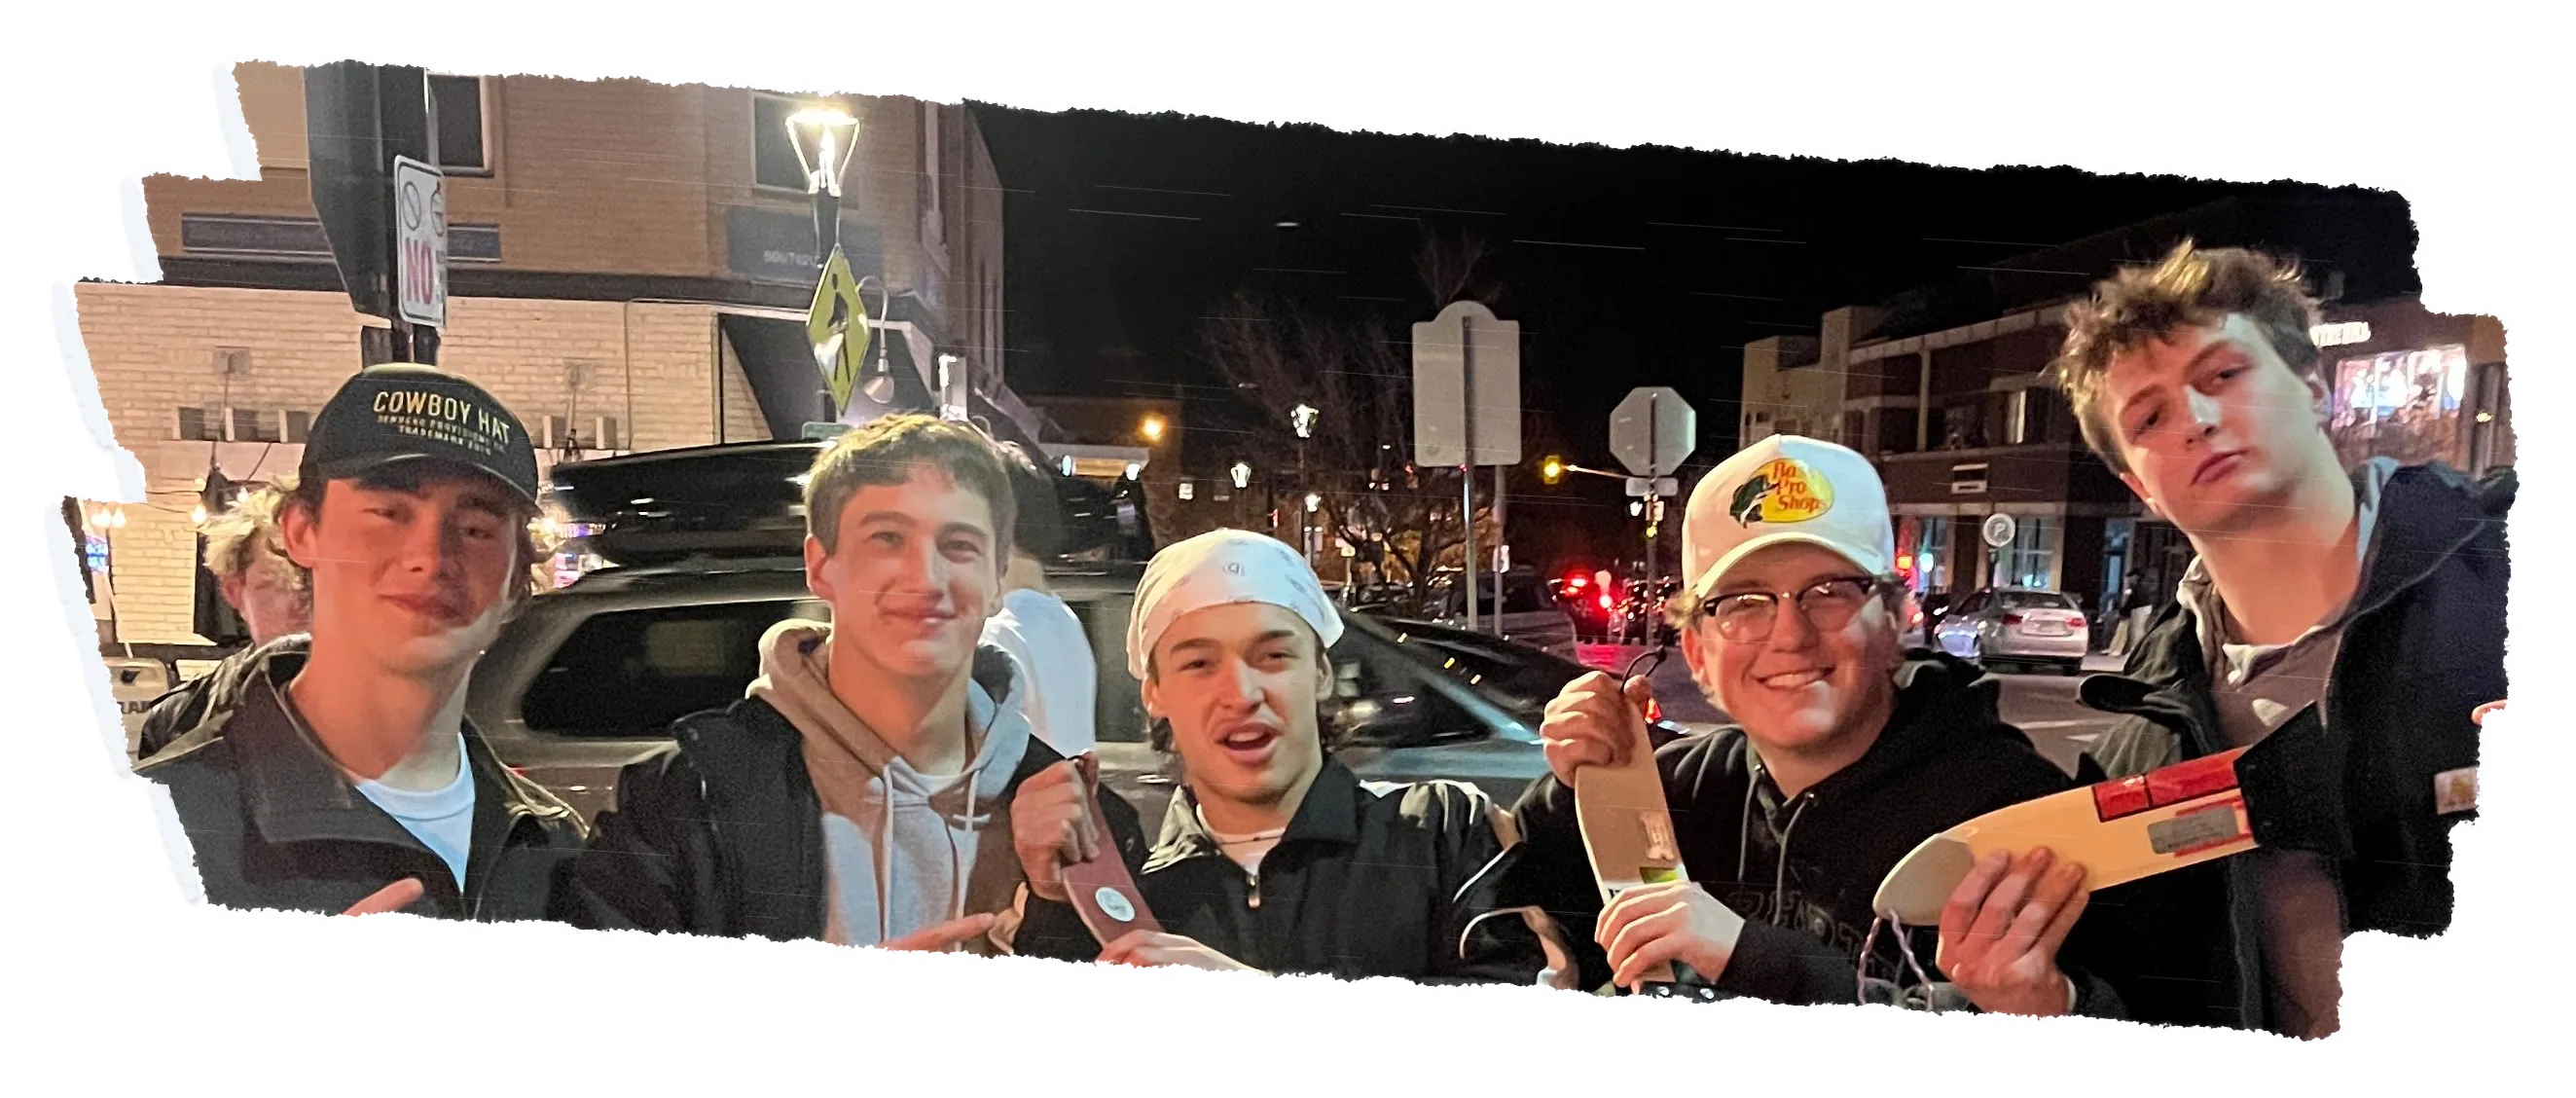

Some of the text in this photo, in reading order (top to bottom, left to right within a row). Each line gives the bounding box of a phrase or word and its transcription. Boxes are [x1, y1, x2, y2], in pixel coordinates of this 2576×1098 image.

[405, 238, 434, 305] NO
[373, 390, 511, 446] COWBOY HAT
[1776, 478, 1808, 495] Pro
